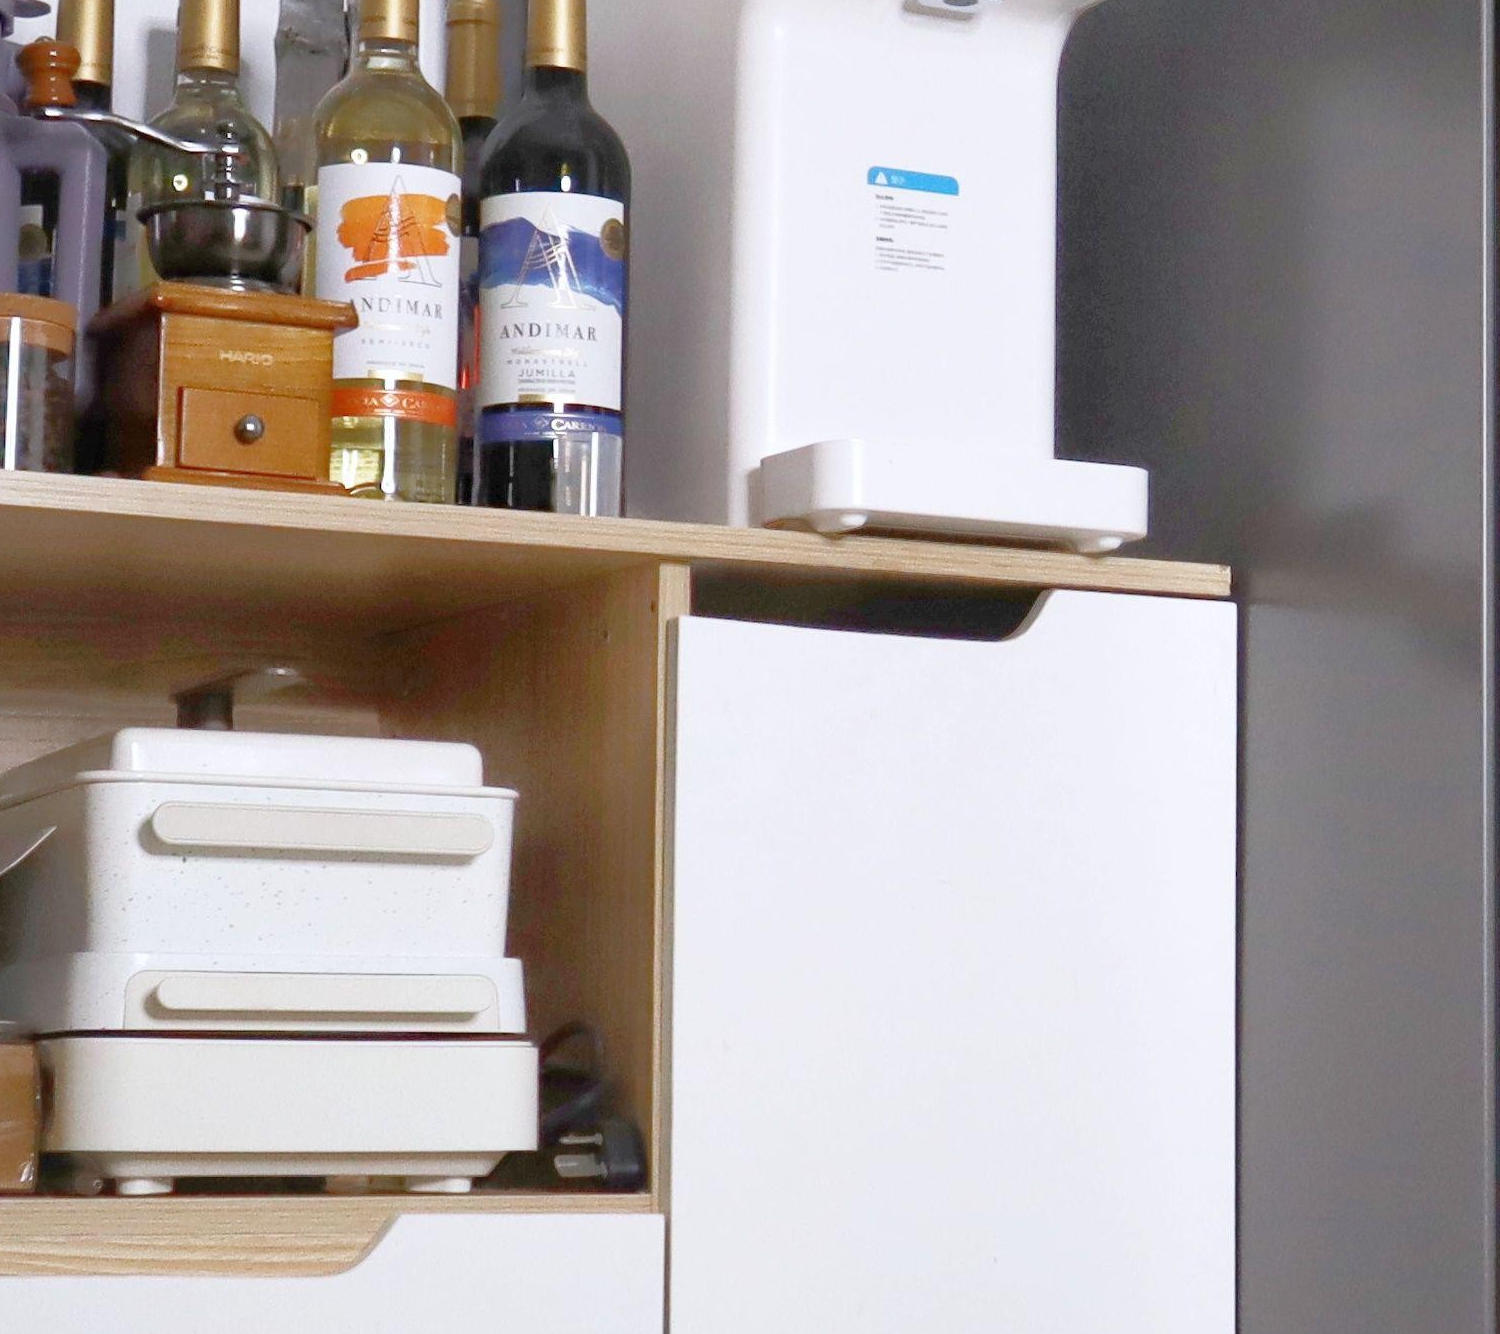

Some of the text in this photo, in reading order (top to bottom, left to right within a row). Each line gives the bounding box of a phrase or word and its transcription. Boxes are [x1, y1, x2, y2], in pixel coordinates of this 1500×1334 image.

[500, 322, 597, 341] ANDIMAR
[219, 349, 274, 366] HARIO
[518, 368, 576, 379] JUMILLA
